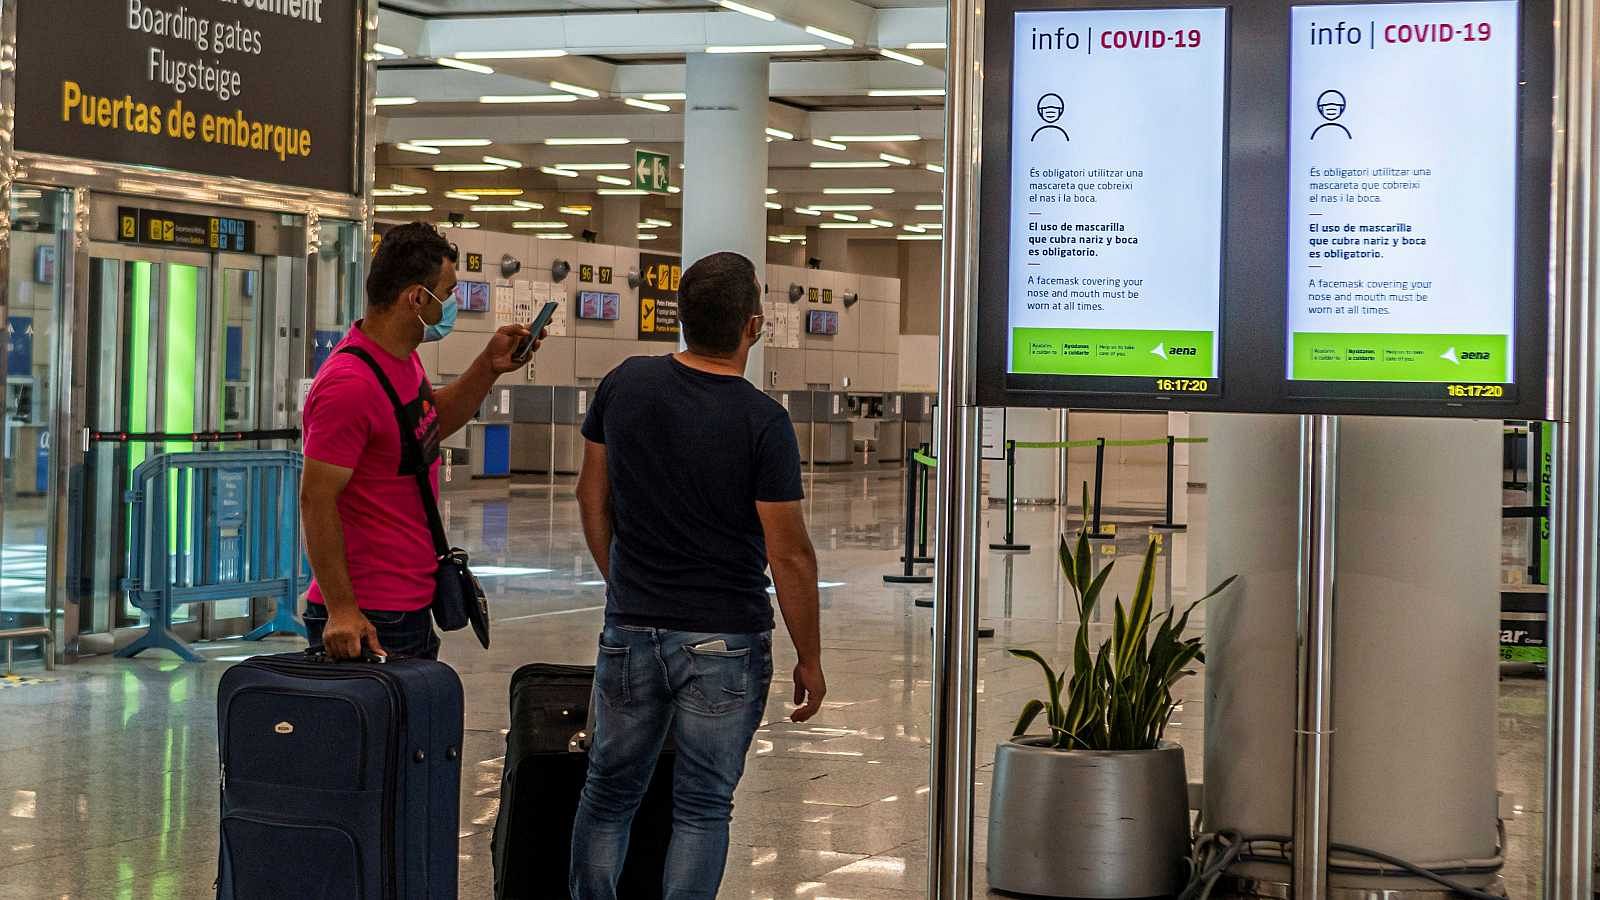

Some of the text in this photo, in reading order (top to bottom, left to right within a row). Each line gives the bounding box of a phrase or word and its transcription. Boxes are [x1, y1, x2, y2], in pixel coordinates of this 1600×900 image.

[128, 0, 262, 54] Boarding gates
[1032, 27, 1201, 50] info COVID-19
[1311, 22, 1491, 45] info COVID-19
[150, 48, 242, 100] Flugsteige
[63, 81, 312, 161] Puertas de embarque
[1030, 166, 1144, 179] És obligatori utilitzar una
[1323, 167, 1369, 178] obligatori
[1372, 168, 1411, 177] utilitzar
[1413, 168, 1432, 176] una
[1029, 181, 1133, 191] mascareta que cobreixi
[1309, 182, 1359, 190] mascareta
[1361, 182, 1380, 191] que
[1029, 193, 1038, 202] el
[1039, 195, 1056, 203] nas
[1063, 193, 1072, 202] la
[1073, 193, 1097, 203] boca.
[1309, 193, 1318, 203] el
[1321, 195, 1338, 203] nas
[1346, 193, 1355, 203] la
[1028, 222, 1038, 231] El
[1060, 222, 1073, 231] de
[1075, 222, 1125, 232] mascarilla
[1309, 223, 1412, 233] El uso de mascarilla
[1028, 235, 1138, 246] que cubra nariz y boca
[1309, 236, 1427, 248] que cubra nariz y boca
[1028, 247, 1099, 258] es obligatorio.
[1309, 248, 1384, 260] es obligatorio.
[469, 256, 480, 269] 95
[582, 267, 592, 280] 96
[601, 269, 611, 281] 97
[1027, 275, 1144, 288] A facemask covering your
[1308, 278, 1433, 291] A facemask covering your
[1027, 288, 1139, 299] nose and mouth must be
[1308, 291, 1428, 302] nose and mouth must be
[1027, 301, 1105, 311] worn at all times.
[1308, 305, 1333, 315] worn
[1335, 305, 1345, 315] at
[1347, 304, 1359, 315] all
[1169, 347, 1197, 356] aena
[1461, 351, 1490, 360] aena
[1157, 379, 1208, 391] 16:17:20
[1447, 385, 1503, 397] 16:17:20
